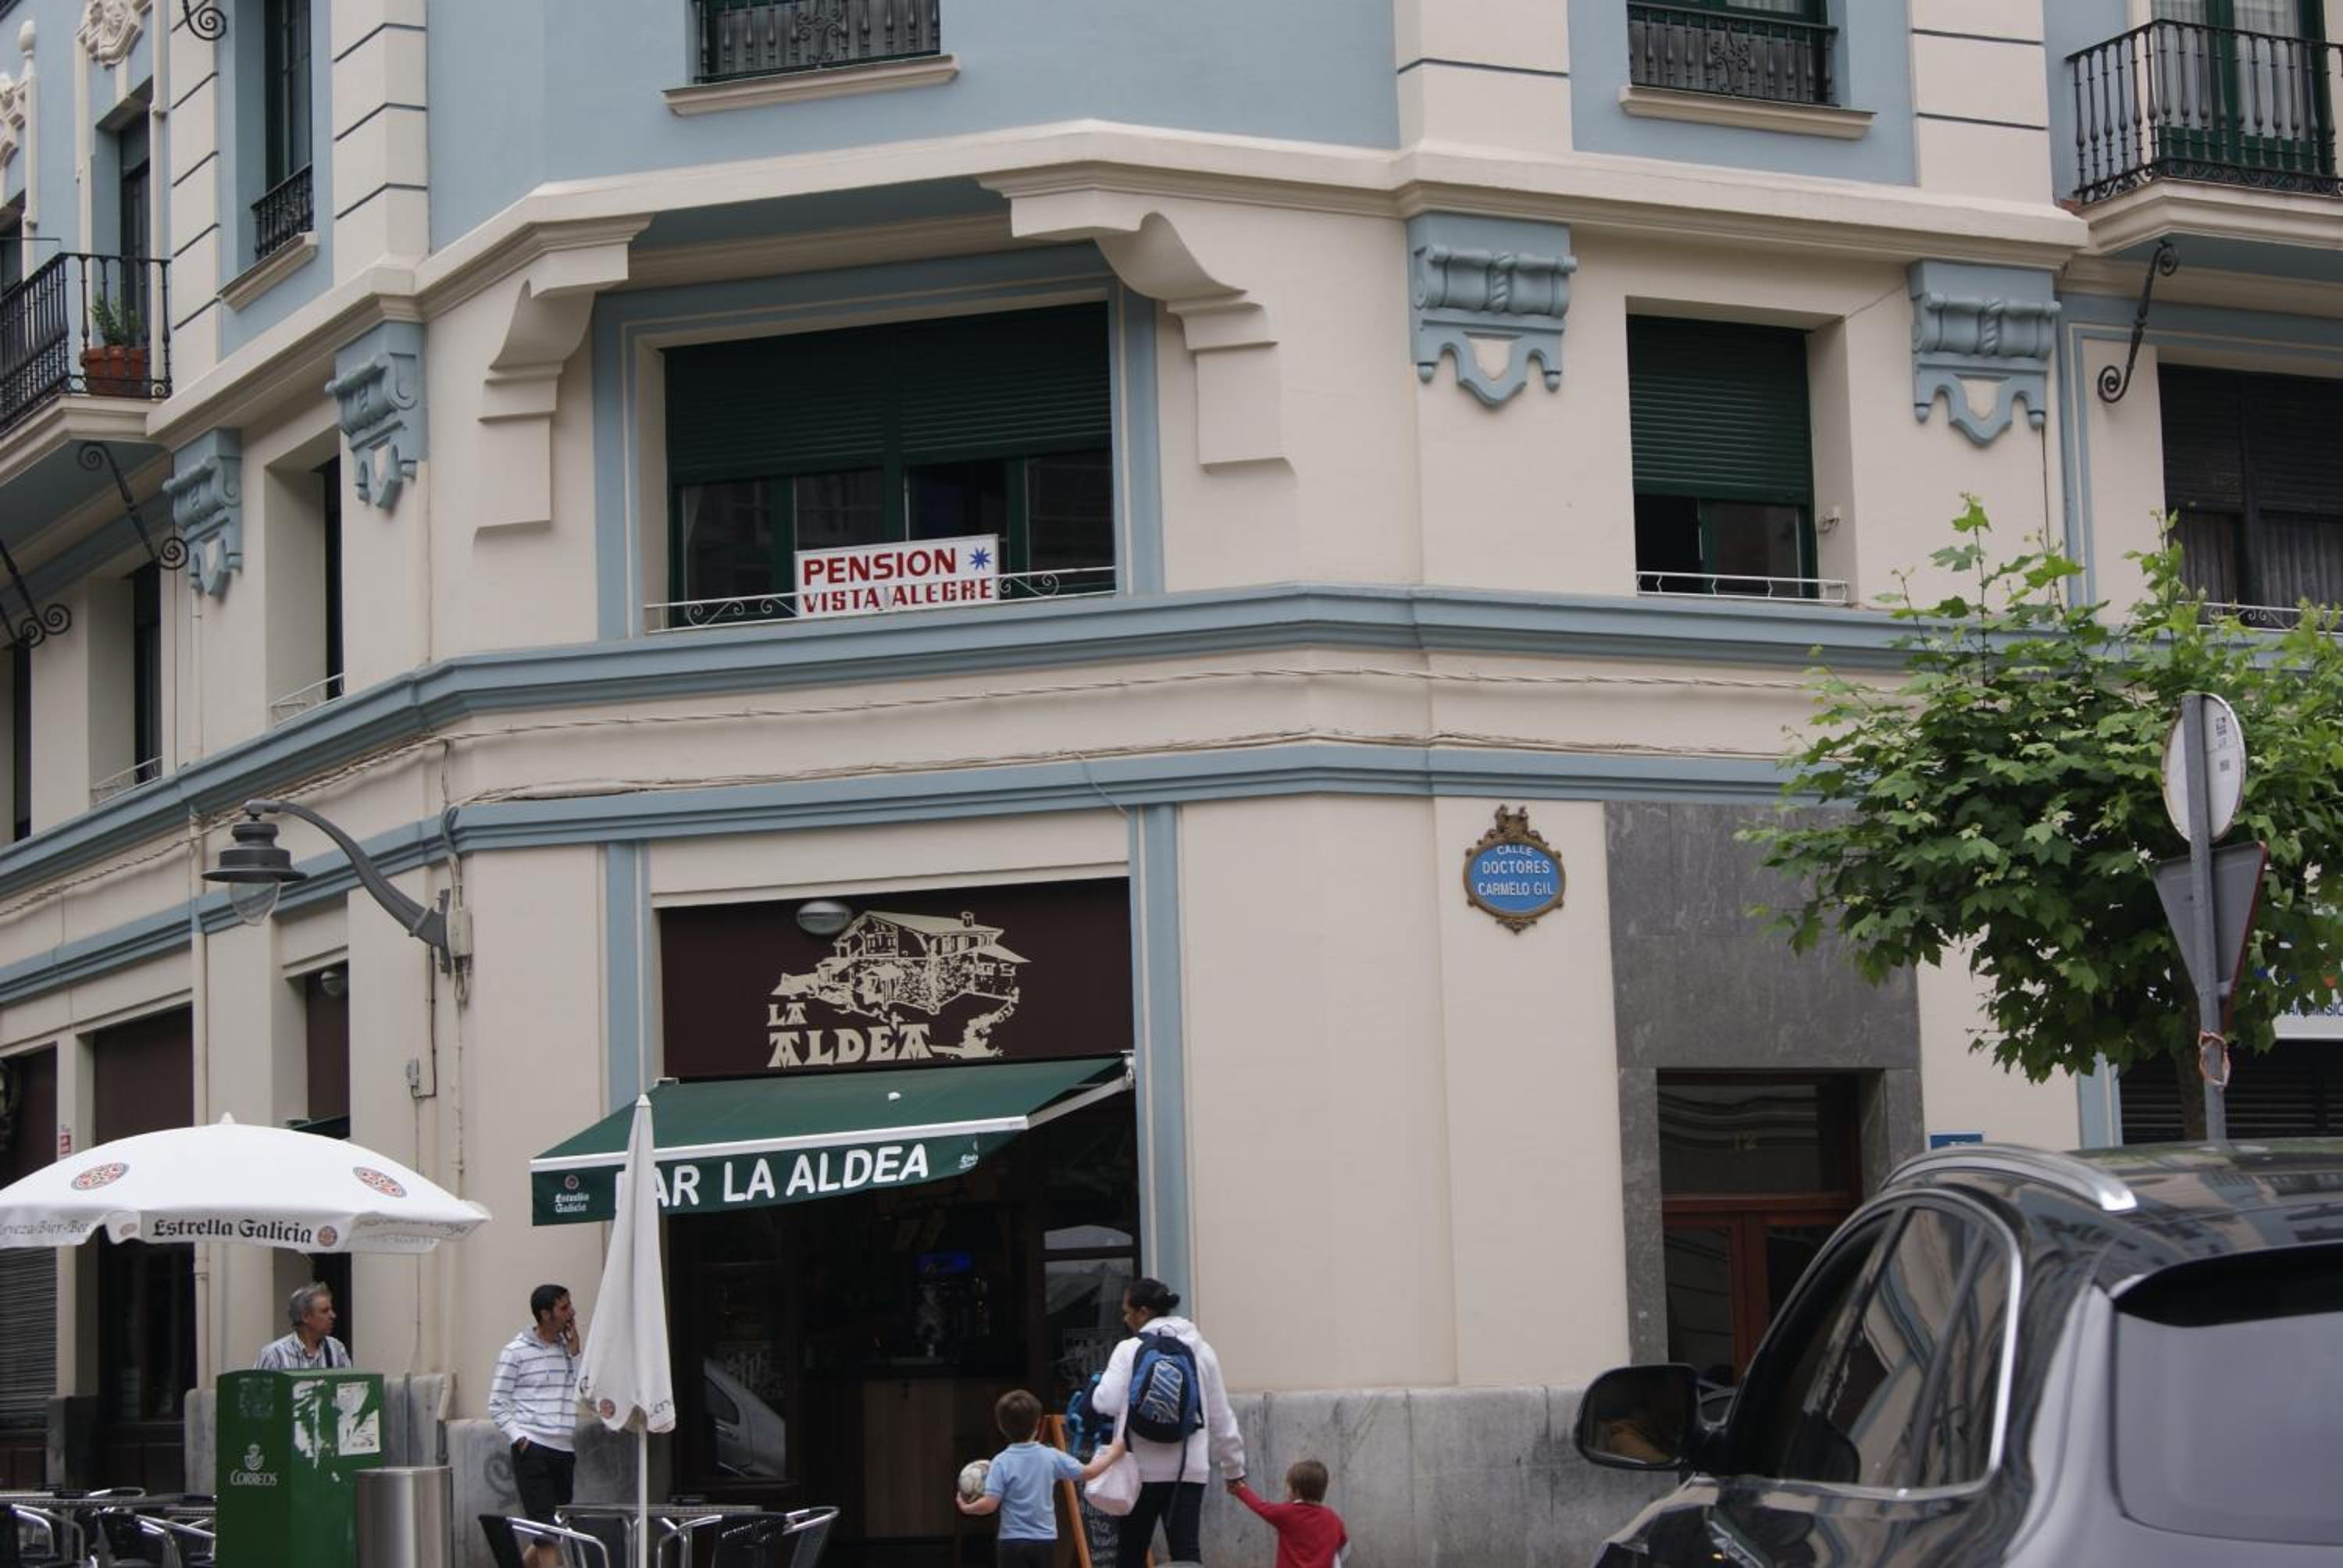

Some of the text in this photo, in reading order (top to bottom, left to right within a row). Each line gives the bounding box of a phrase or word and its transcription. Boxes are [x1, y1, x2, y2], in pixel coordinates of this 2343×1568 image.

[804, 547, 956, 586] PENSION
[804, 578, 993, 613] VISTA ALEGRE
[1498, 845, 1533, 856] CALLE
[1482, 860, 1550, 874] DOCTORES
[1478, 882, 1553, 896] CARMELO GIL
[767, 1002, 808, 1027] LA
[767, 1024, 933, 1068] ALDEA
[724, 1158, 776, 1203] LA
[786, 1143, 929, 1196] ALDEA
[153, 1219, 312, 1244] Estrella Galicia
